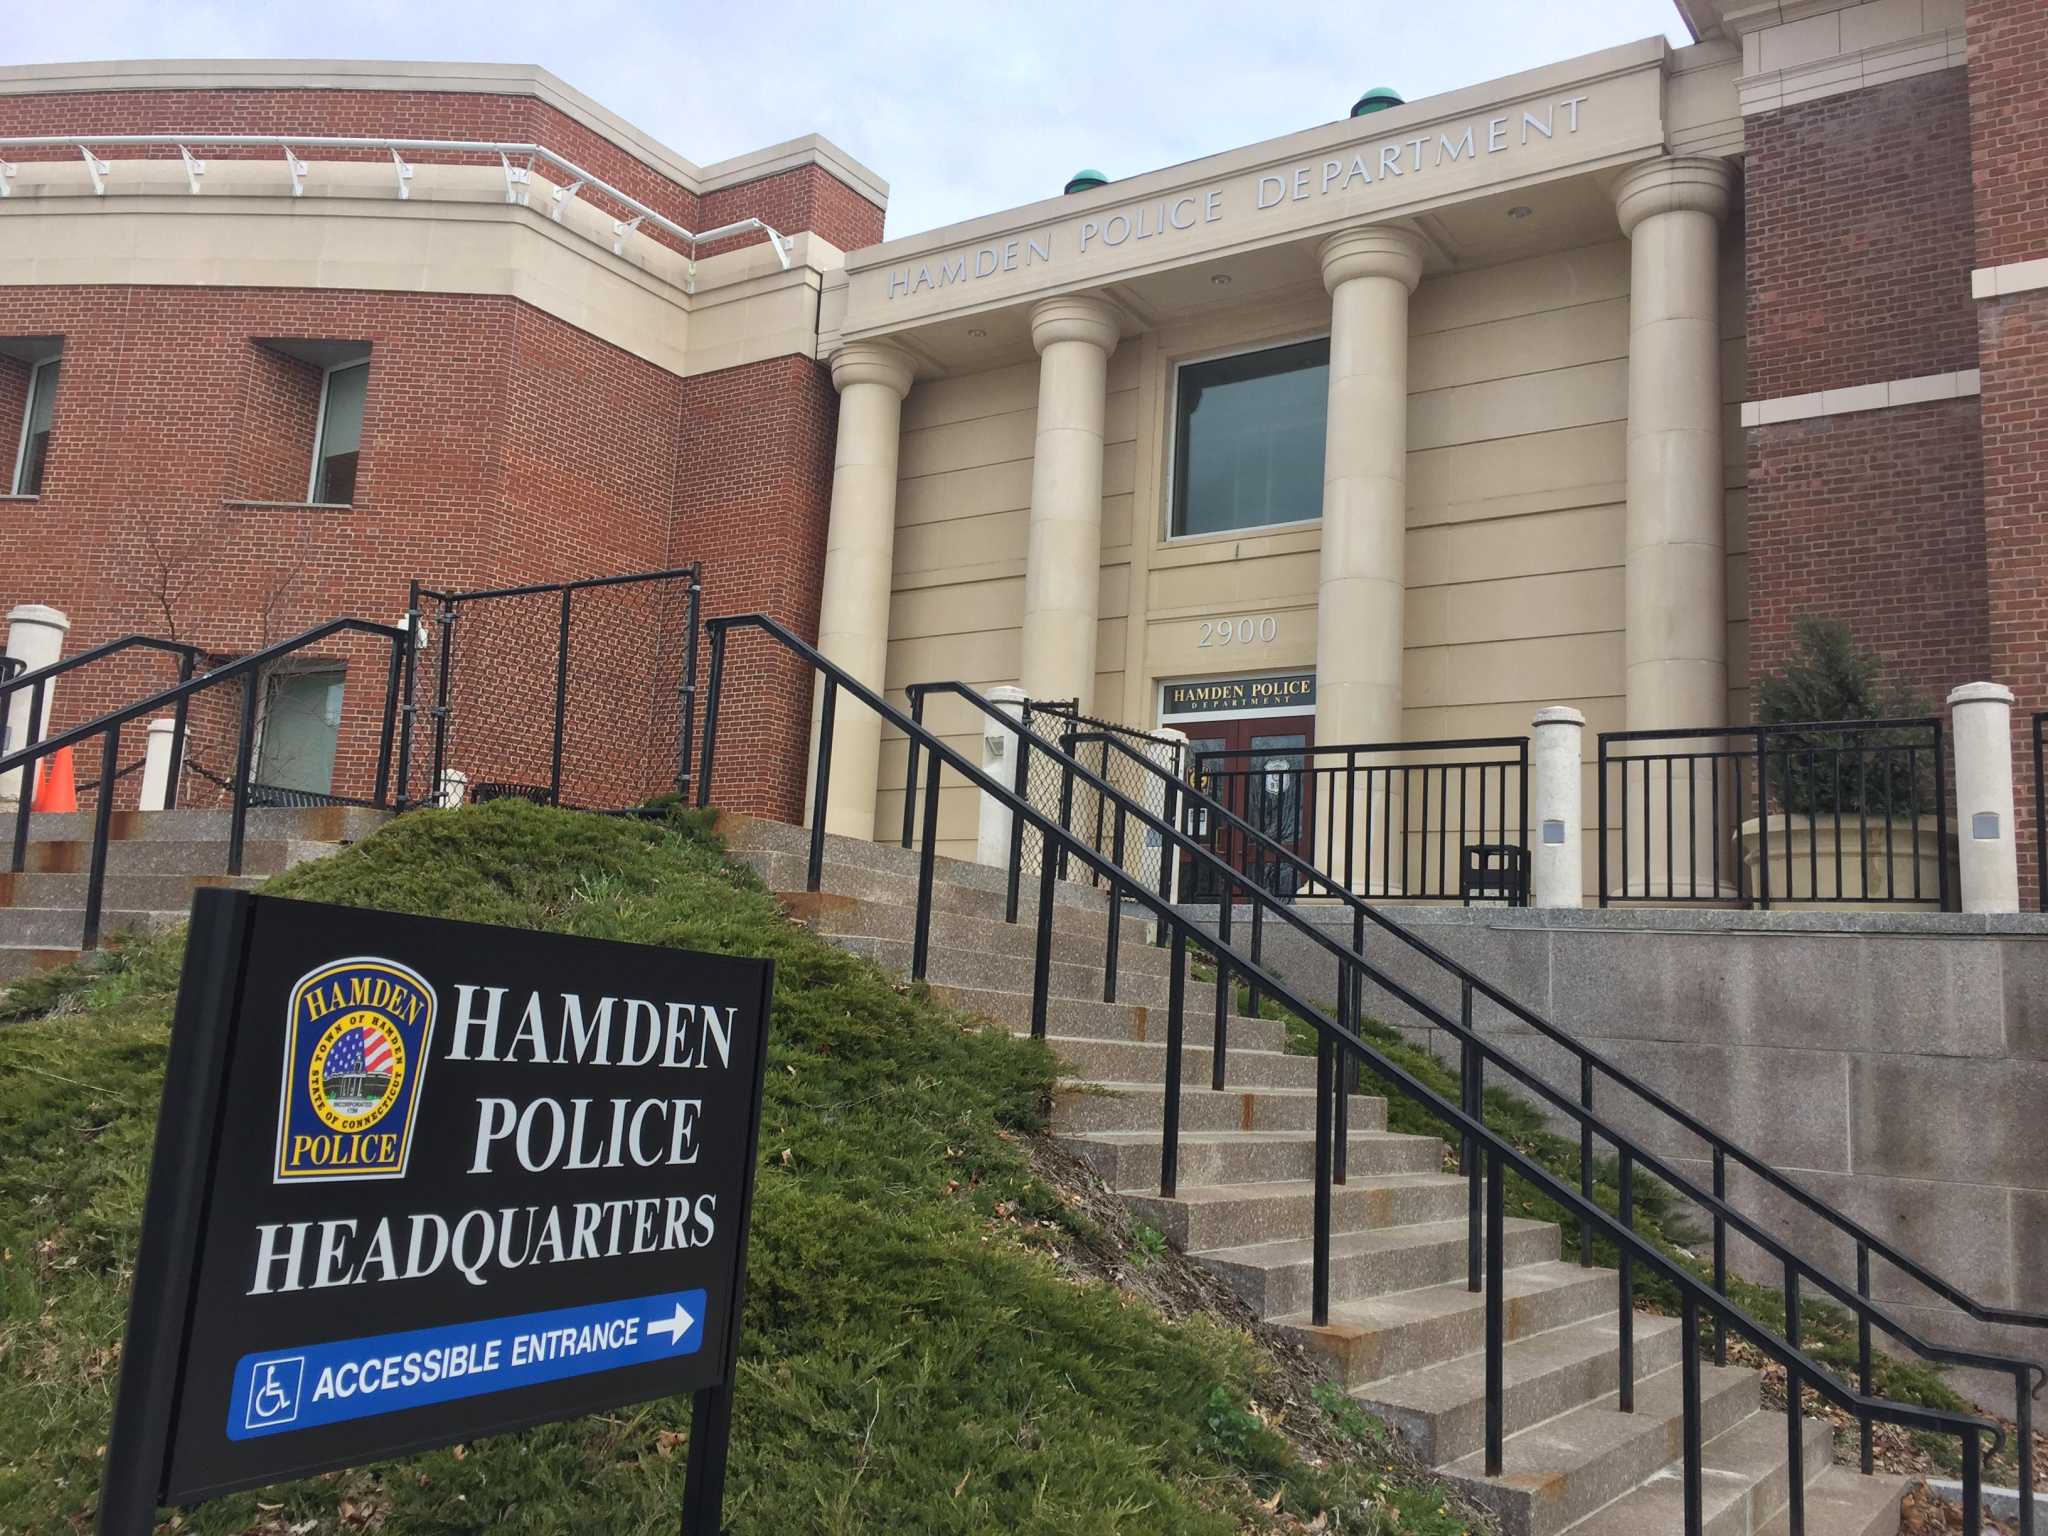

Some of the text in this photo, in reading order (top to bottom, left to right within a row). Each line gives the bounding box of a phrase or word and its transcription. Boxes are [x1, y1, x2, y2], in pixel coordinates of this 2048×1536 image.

[887, 96, 1590, 300] HAMDEN POLICE DEPARTMENT
[1198, 616, 1278, 648] 2900
[1174, 680, 1311, 702] HAMDEN POLICE
[1191, 695, 1290, 709] DEPARTMENT
[304, 977, 425, 1026] HAMDEN
[444, 984, 738, 1070] HAMDEN
[314, 1015, 403, 1065] TOWN OF HAMDEN
[311, 1070, 403, 1129] STATE OF CONNECTICUT
[290, 1133, 397, 1166] POLICE
[466, 1097, 702, 1176] POLICE
[245, 1193, 718, 1296] HEADQUARTERS
[312, 1316, 641, 1403] ACCESSIBLE ENTRANCE
